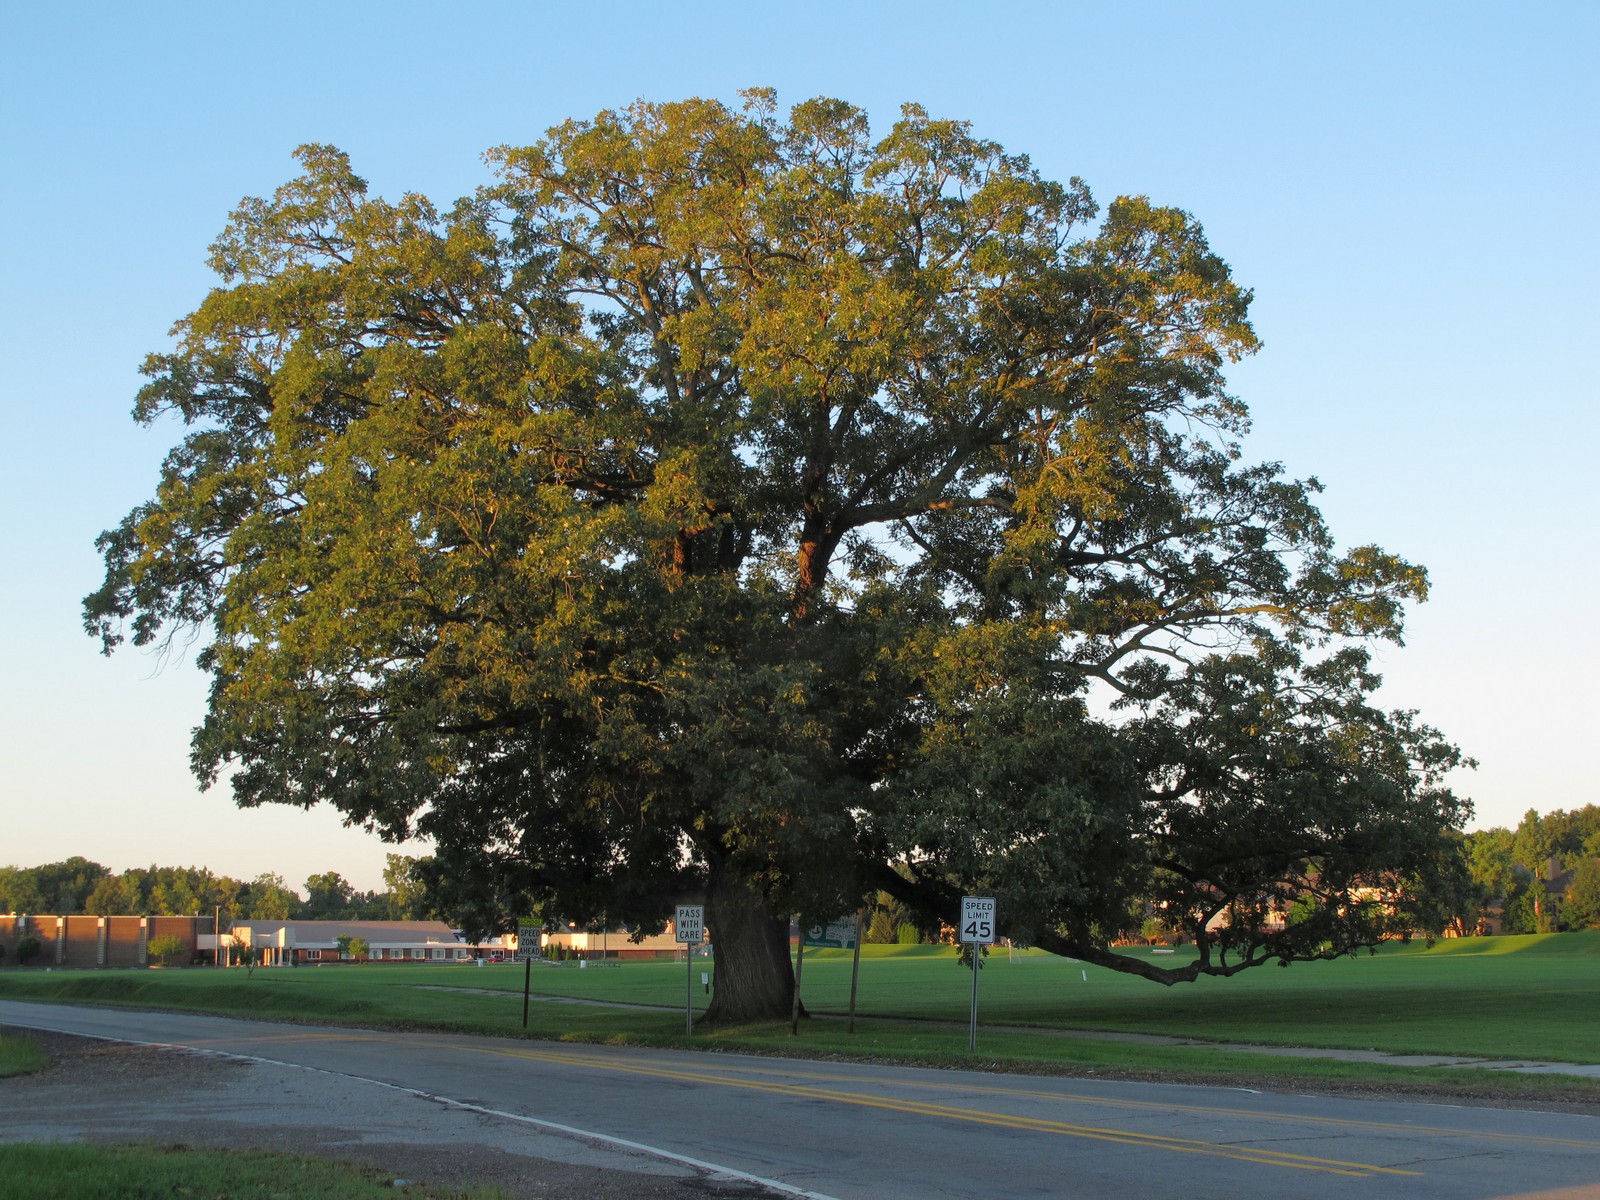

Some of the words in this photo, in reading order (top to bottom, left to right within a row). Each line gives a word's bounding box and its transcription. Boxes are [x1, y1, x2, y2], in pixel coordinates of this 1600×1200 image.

[965, 902, 993, 910] SPEED
[679, 909, 700, 918] PASS
[680, 920, 699, 928] WITH
[964, 920, 991, 938] 45
[679, 930, 700, 939] CARE
[521, 938, 538, 946] ZONE
[519, 947, 540, 955] AHEAD
